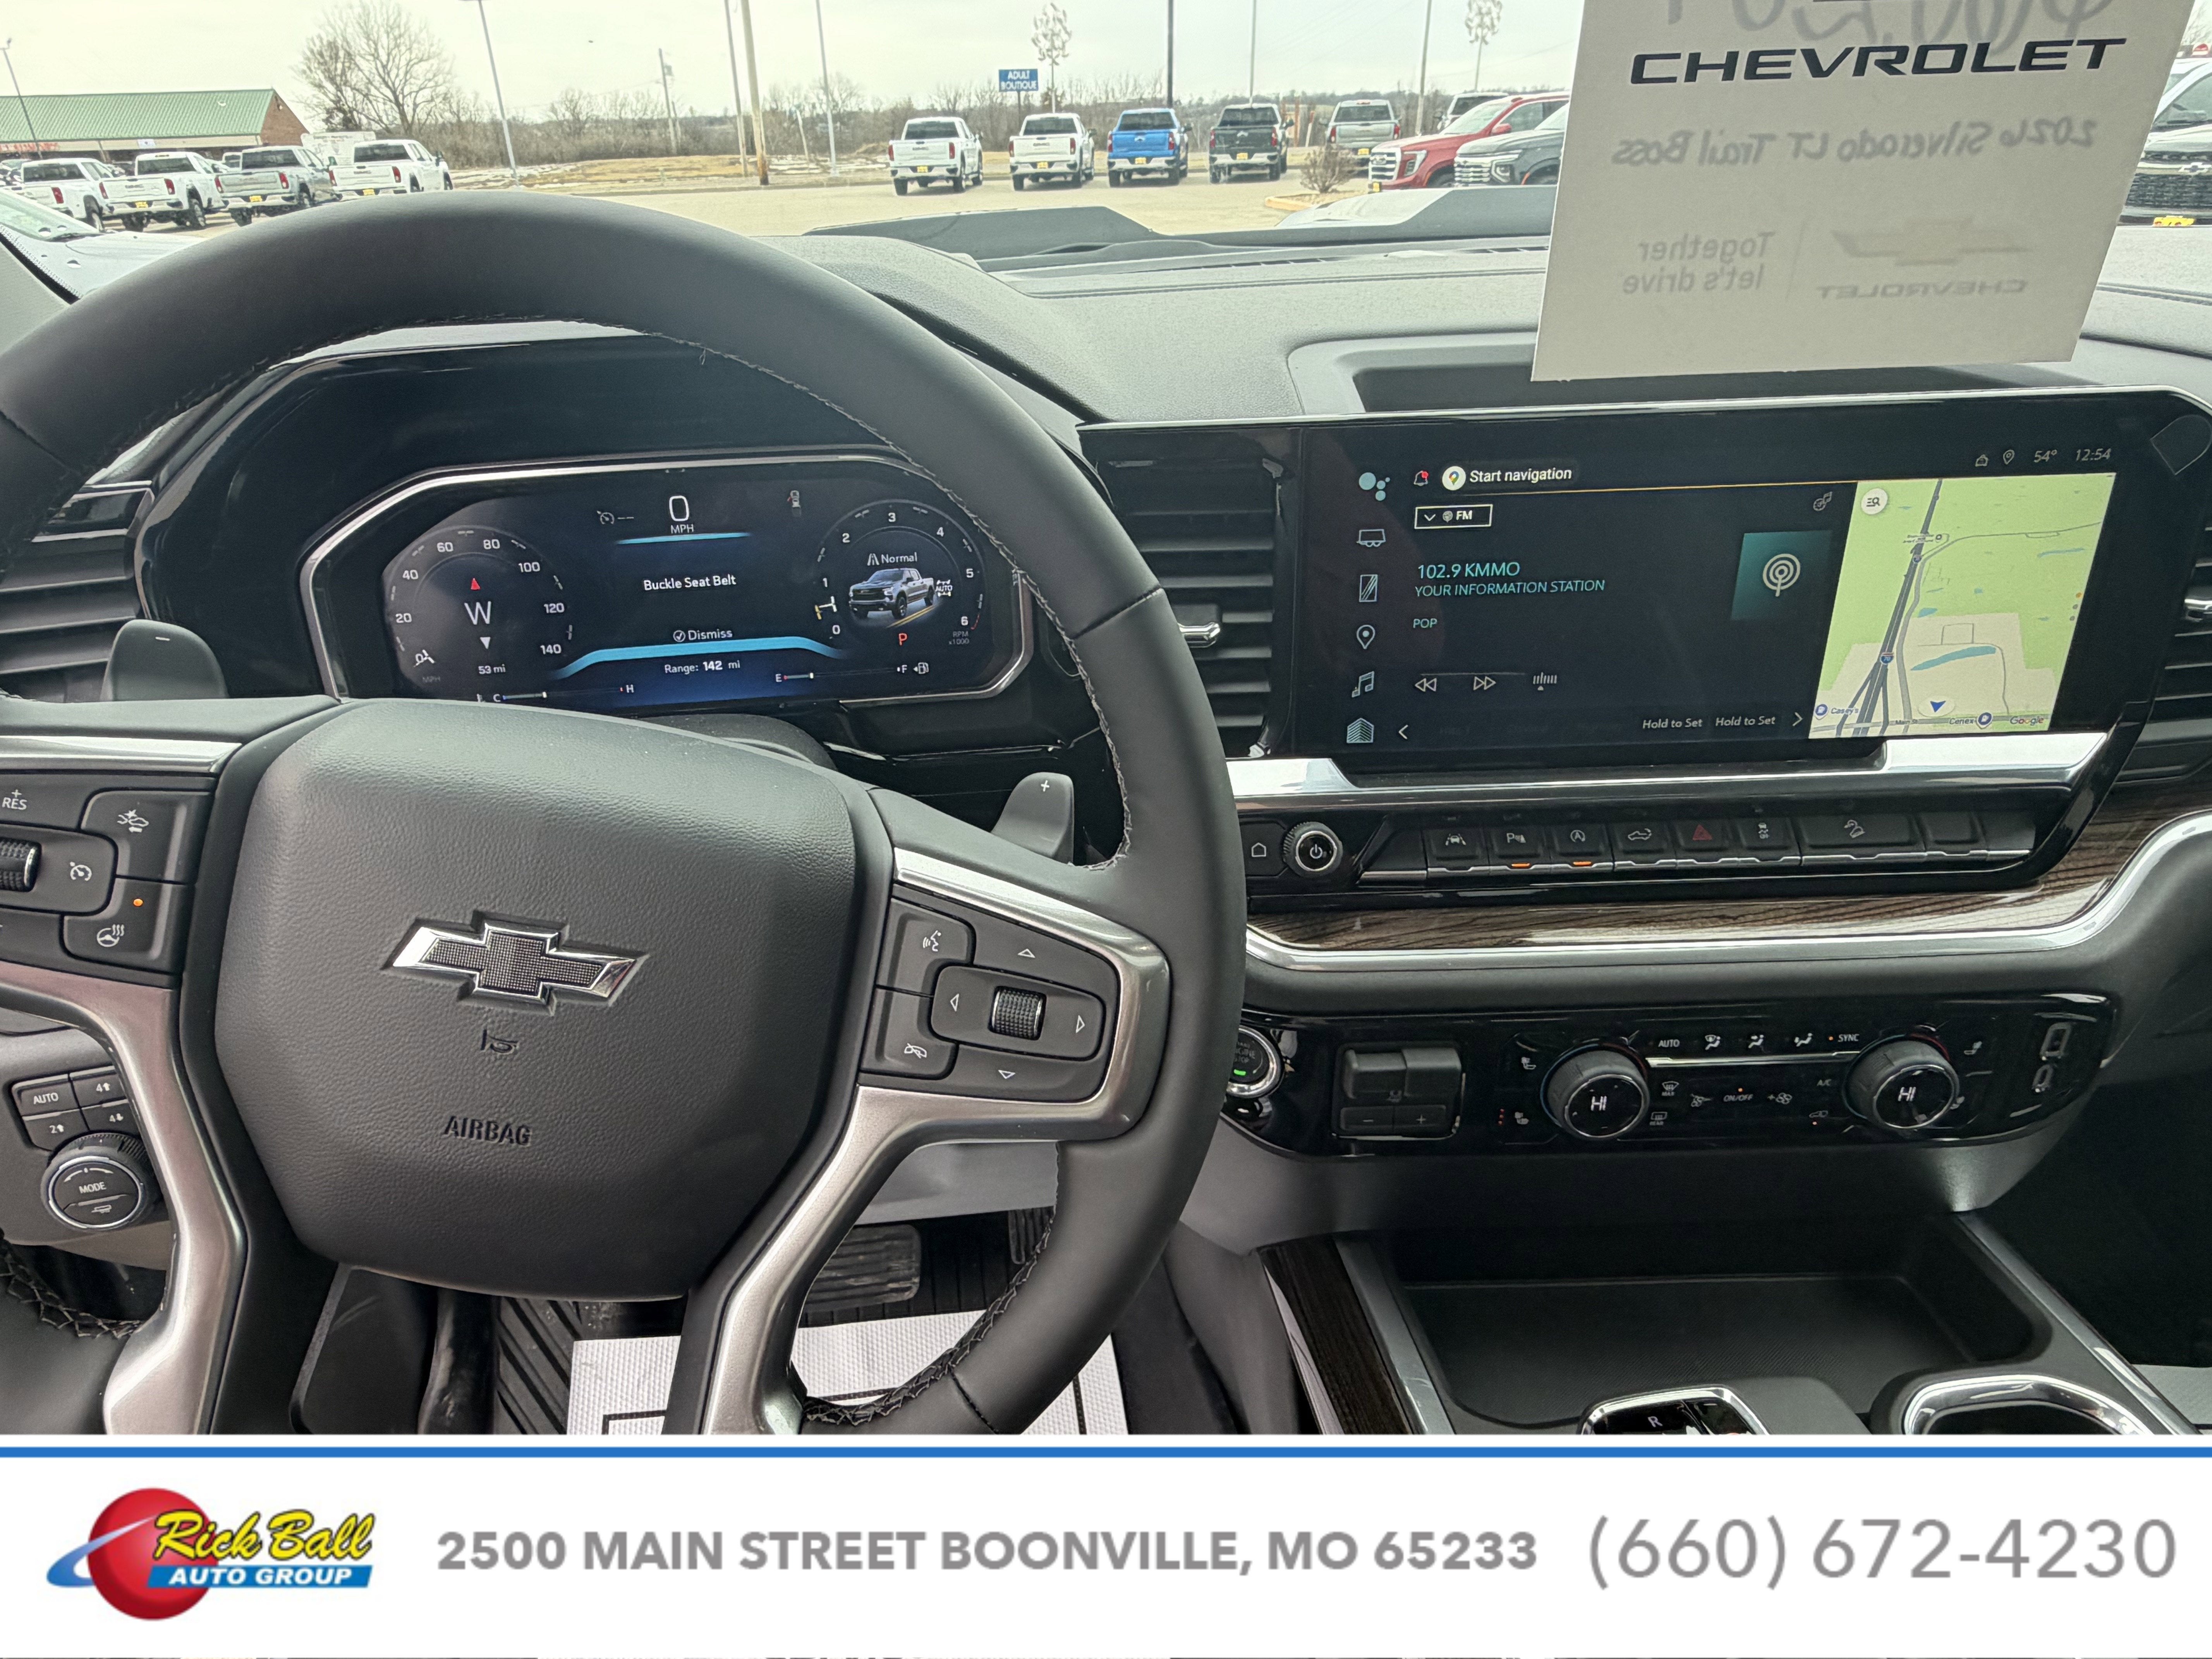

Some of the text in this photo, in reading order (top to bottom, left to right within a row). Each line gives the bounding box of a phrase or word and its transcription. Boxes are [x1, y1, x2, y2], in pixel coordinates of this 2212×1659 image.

[1630, 38, 2127, 84] CHEVROLET
[1008, 70, 1030, 80] ADULT
[1001, 80, 1037, 90] BOUTIQUE
[2076, 448, 2111, 461] 12:54
[1469, 467, 1572, 483] Start navigation
[669, 495, 690, 522] 0
[888, 512, 896, 522] 3
[1456, 510, 1473, 520] FM
[670, 524, 694, 534] MPH
[936, 527, 944, 537] 4
[842, 533, 850, 543] 2
[436, 541, 454, 553] 60
[483, 539, 500, 550] 80
[881, 552, 918, 564] Normal
[518, 562, 541, 573] 100
[966, 568, 974, 578] 5
[1418, 561, 1521, 579] 102.9 KMMO
[402, 570, 419, 580] 40
[643, 574, 737, 591] Buckle Seat Belt
[822, 577, 828, 587] 1
[1415, 579, 1606, 597] YOUR INFORMATION STATION
[464, 600, 492, 625] W
[543, 603, 565, 614] 120
[395, 613, 412, 624] 20
[960, 616, 969, 626] 6
[1412, 618, 1438, 629] POP
[687, 629, 733, 641] Dismiss
[832, 625, 841, 635] 0
[898, 632, 908, 646] P
[540, 644, 562, 655] 140
[478, 664, 506, 675] 53 mi
[664, 660, 740, 675] Range: 142 mi
[902, 665, 907, 673] F
[775, 673, 782, 682] E
[626, 685, 634, 693] H
[493, 693, 501, 702] C
[1642, 718, 1703, 729] Hold to Set
[1715, 715, 1776, 726] Hold to Set
[2010, 716, 2044, 726] Google
[2, 797, 27, 811] RES
[1658, 1039, 1680, 1048] AUTO
[1838, 1034, 1859, 1042] SYNC
[33, 1092, 59, 1104] AUTO
[1723, 1094, 1753, 1102] ON/OFF
[1898, 1086, 1917, 1102] HI
[1590, 1096, 1607, 1111] HI
[443, 1115, 532, 1147] AIRBAG
[79, 1182, 106, 1194] MODE
[1647, 1415, 1663, 1428] R
